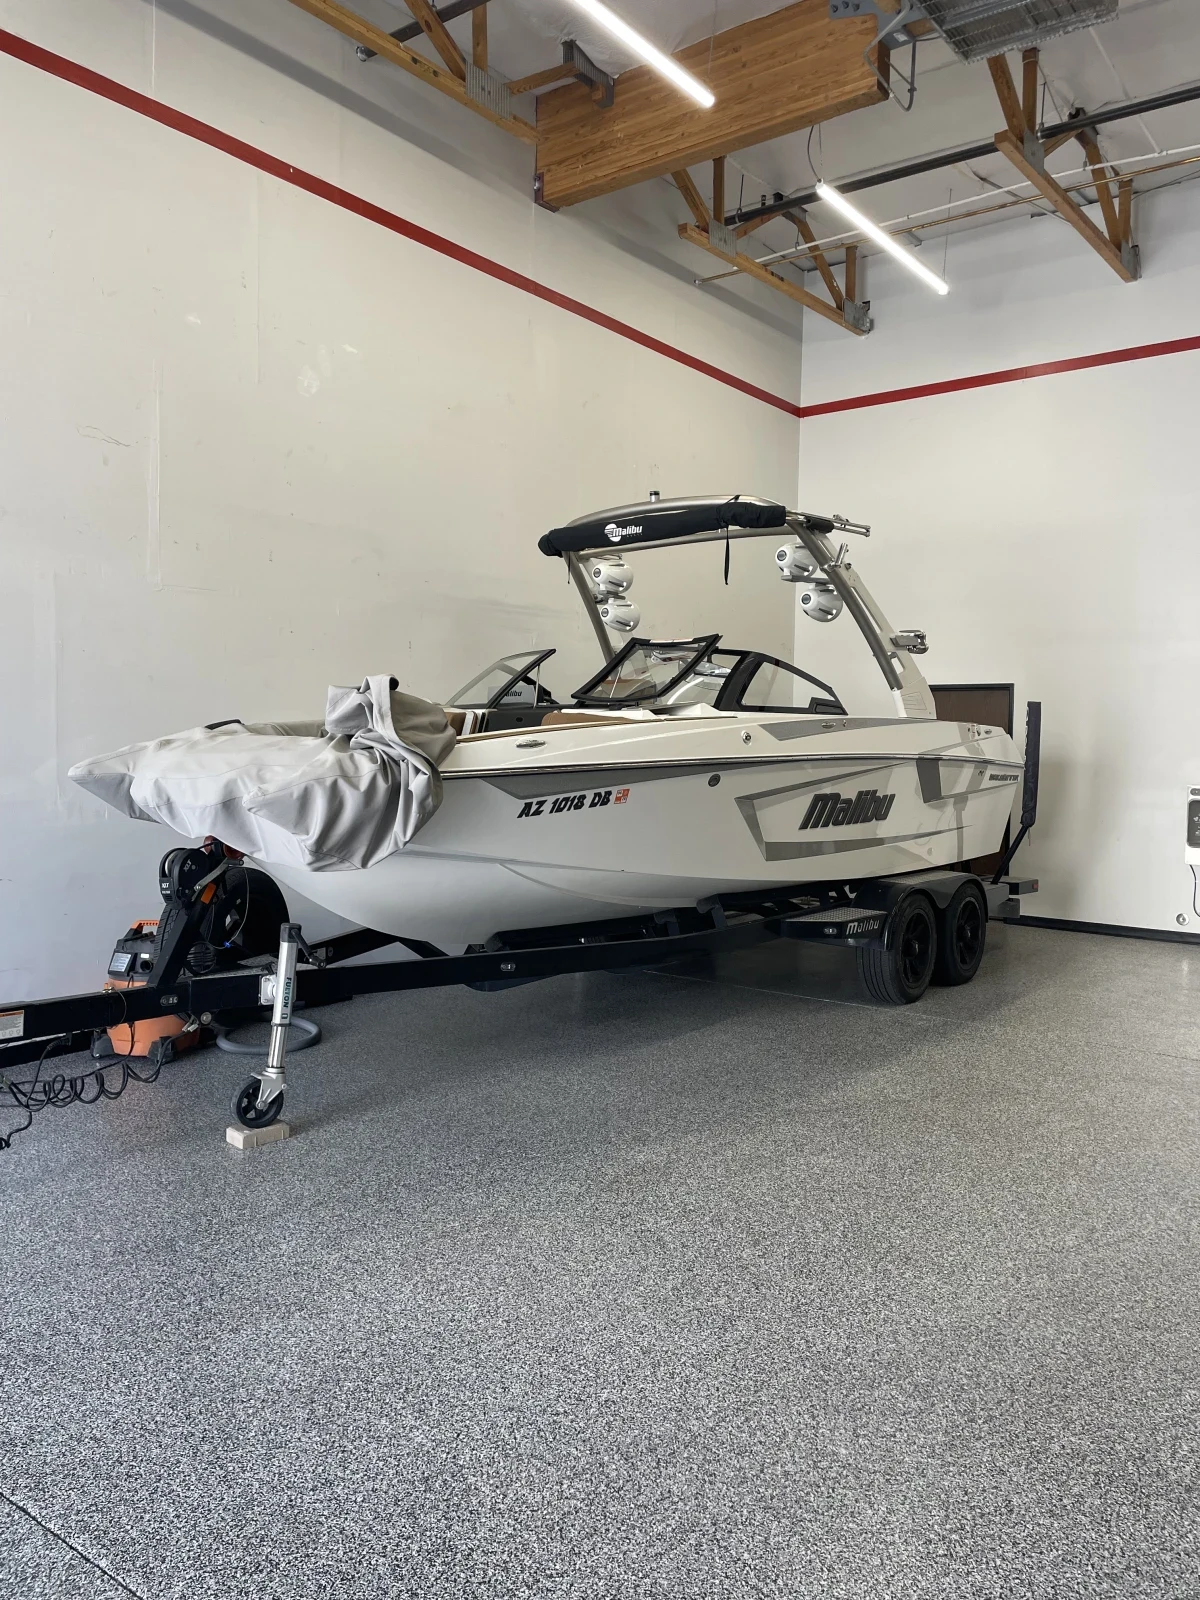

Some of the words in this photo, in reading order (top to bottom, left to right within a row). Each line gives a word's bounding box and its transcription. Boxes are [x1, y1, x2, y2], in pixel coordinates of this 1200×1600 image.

[517, 800, 548, 819] AZ
[549, 794, 587, 815] 1018
[588, 790, 612, 809] DB
[283, 977, 292, 1008] FULTON
